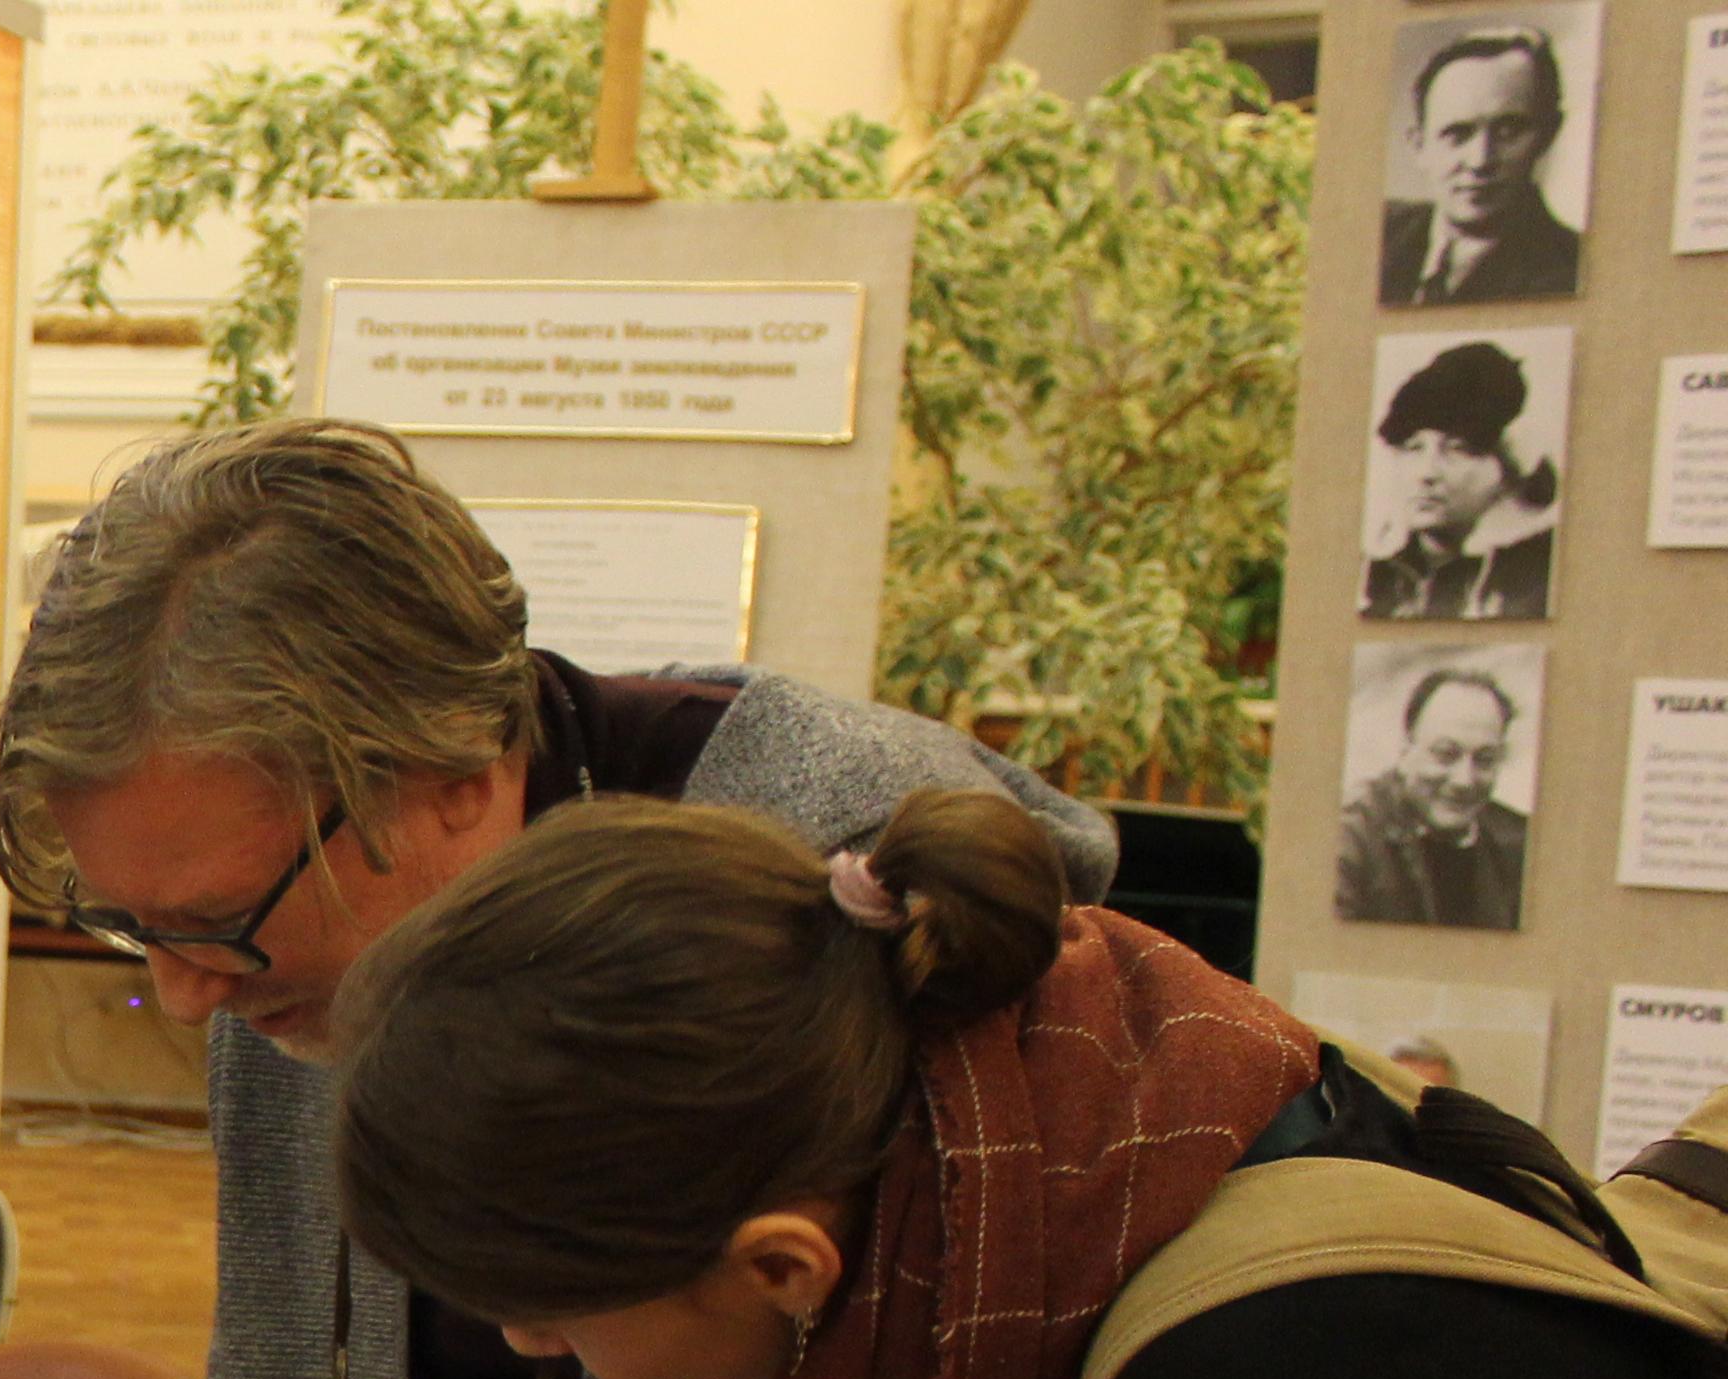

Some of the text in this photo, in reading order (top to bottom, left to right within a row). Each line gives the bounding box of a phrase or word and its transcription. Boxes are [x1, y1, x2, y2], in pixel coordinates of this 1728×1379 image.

[356, 317, 829, 346] Постановление Совета Министров СССР
[370, 351, 797, 381] об организации Музея землеведения
[444, 388, 468, 406] от
[519, 389, 605, 414] августа
[681, 391, 736, 415] года
[1619, 998, 1724, 1024] СМУРОВ
